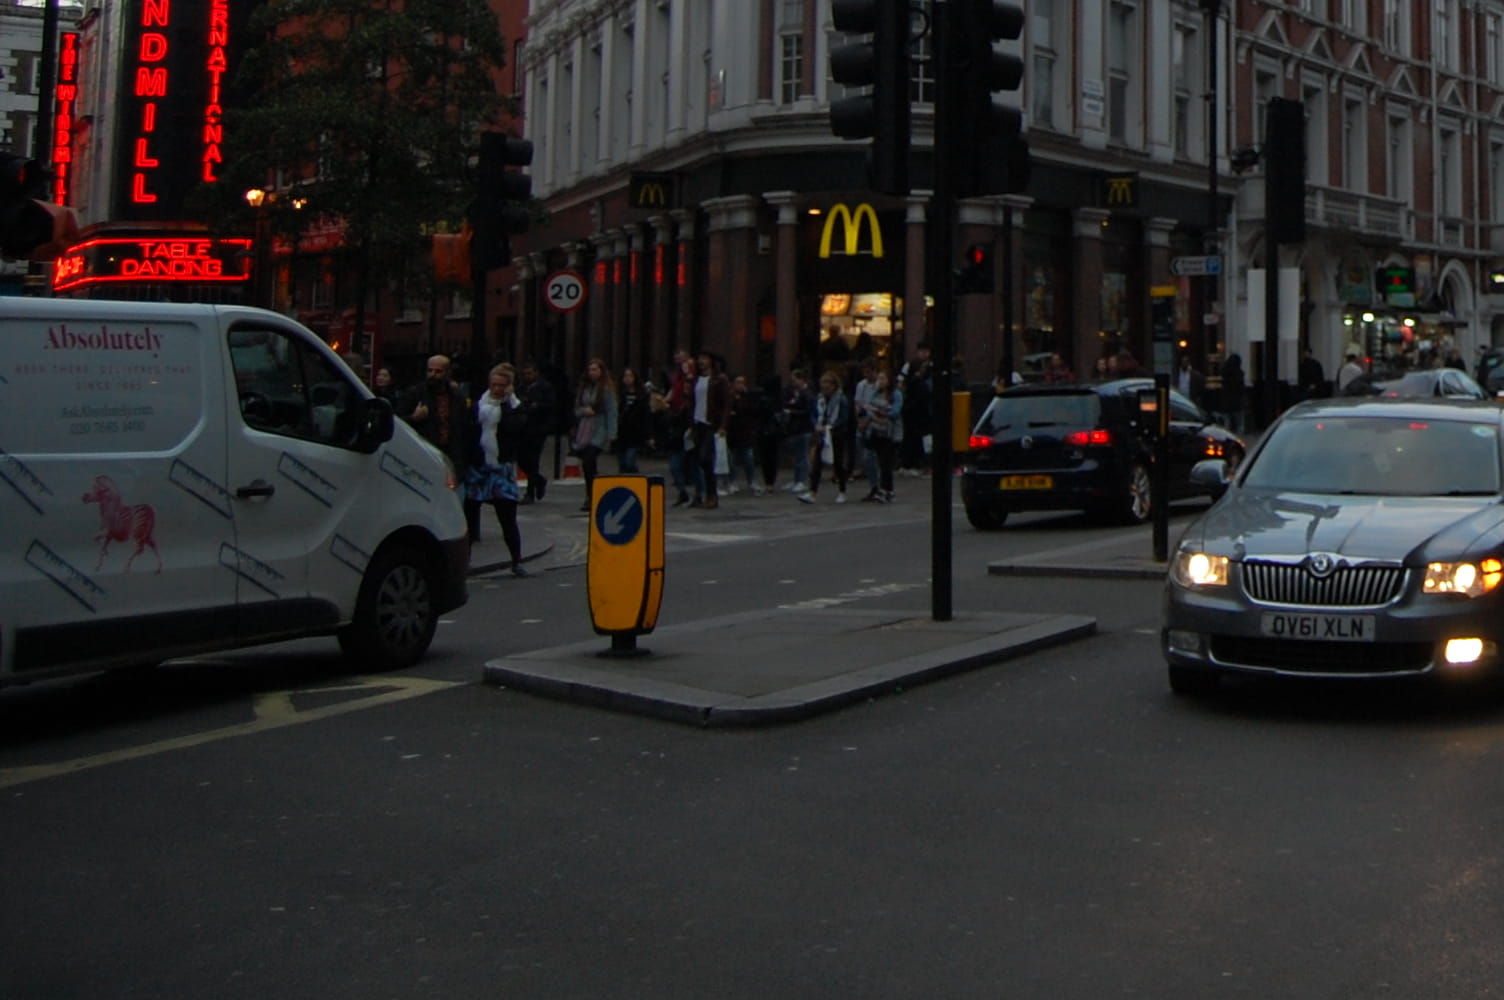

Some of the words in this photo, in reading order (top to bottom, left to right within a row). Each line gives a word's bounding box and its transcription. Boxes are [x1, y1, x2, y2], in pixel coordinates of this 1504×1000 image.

[137, 242, 211, 260] TABLE
[121, 259, 223, 276] DANCING
[551, 283, 580, 300] 20
[43, 324, 163, 359] Absolutely
[1324, 617, 1363, 638] XLN
